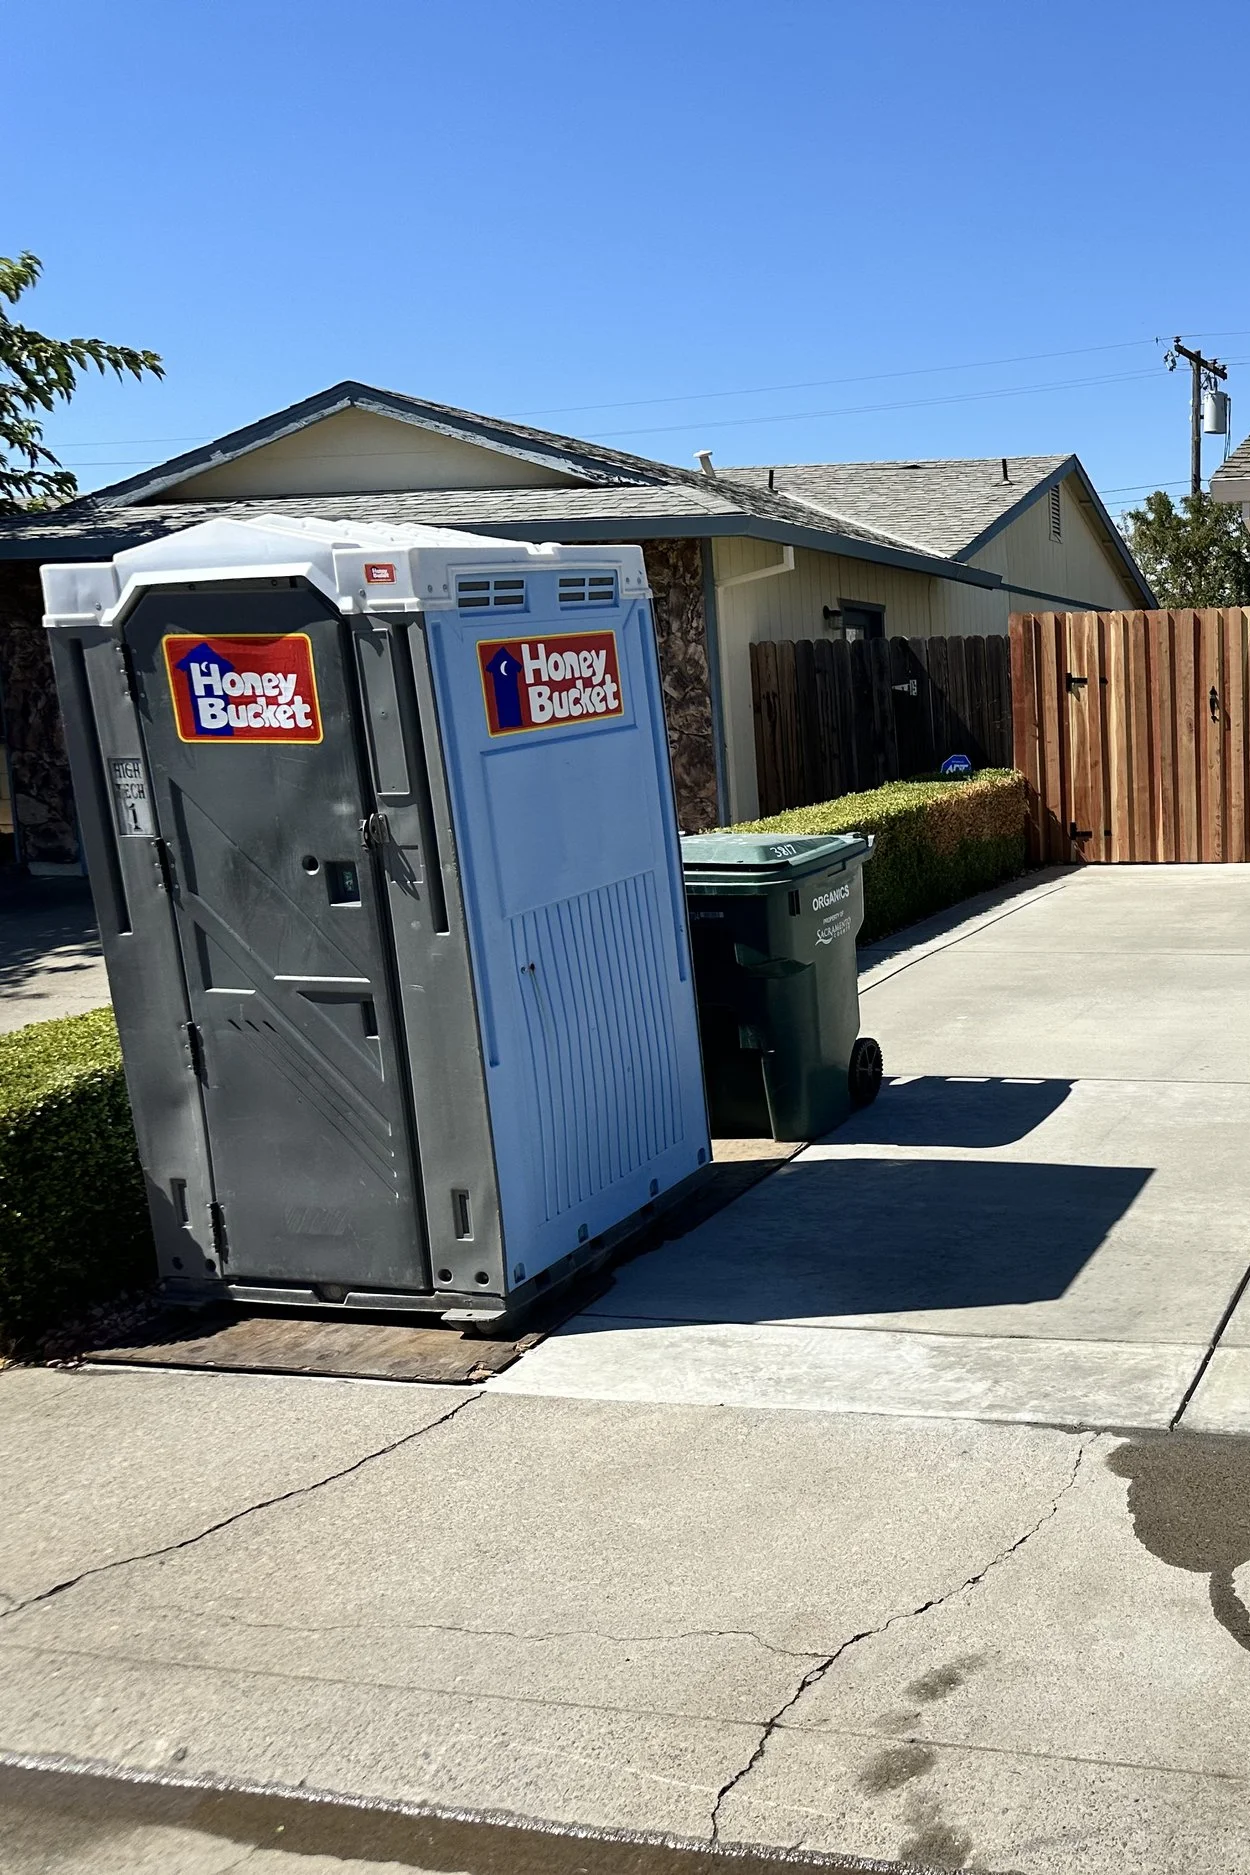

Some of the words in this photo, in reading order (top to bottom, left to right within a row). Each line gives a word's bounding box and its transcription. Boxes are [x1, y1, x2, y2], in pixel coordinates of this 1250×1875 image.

[521, 643, 607, 685] Honey
[190, 662, 297, 705] Honey
[198, 695, 313, 730] Bucket
[528, 673, 619, 724] Bucket
[113, 762, 142, 779] HIGH
[115, 783, 146, 799] TECH
[128, 802, 143, 831] 1
[769, 843, 797, 858] 3817
[812, 884, 850, 911] ORGANICS
[816, 916, 852, 940] SACRAMENTO
